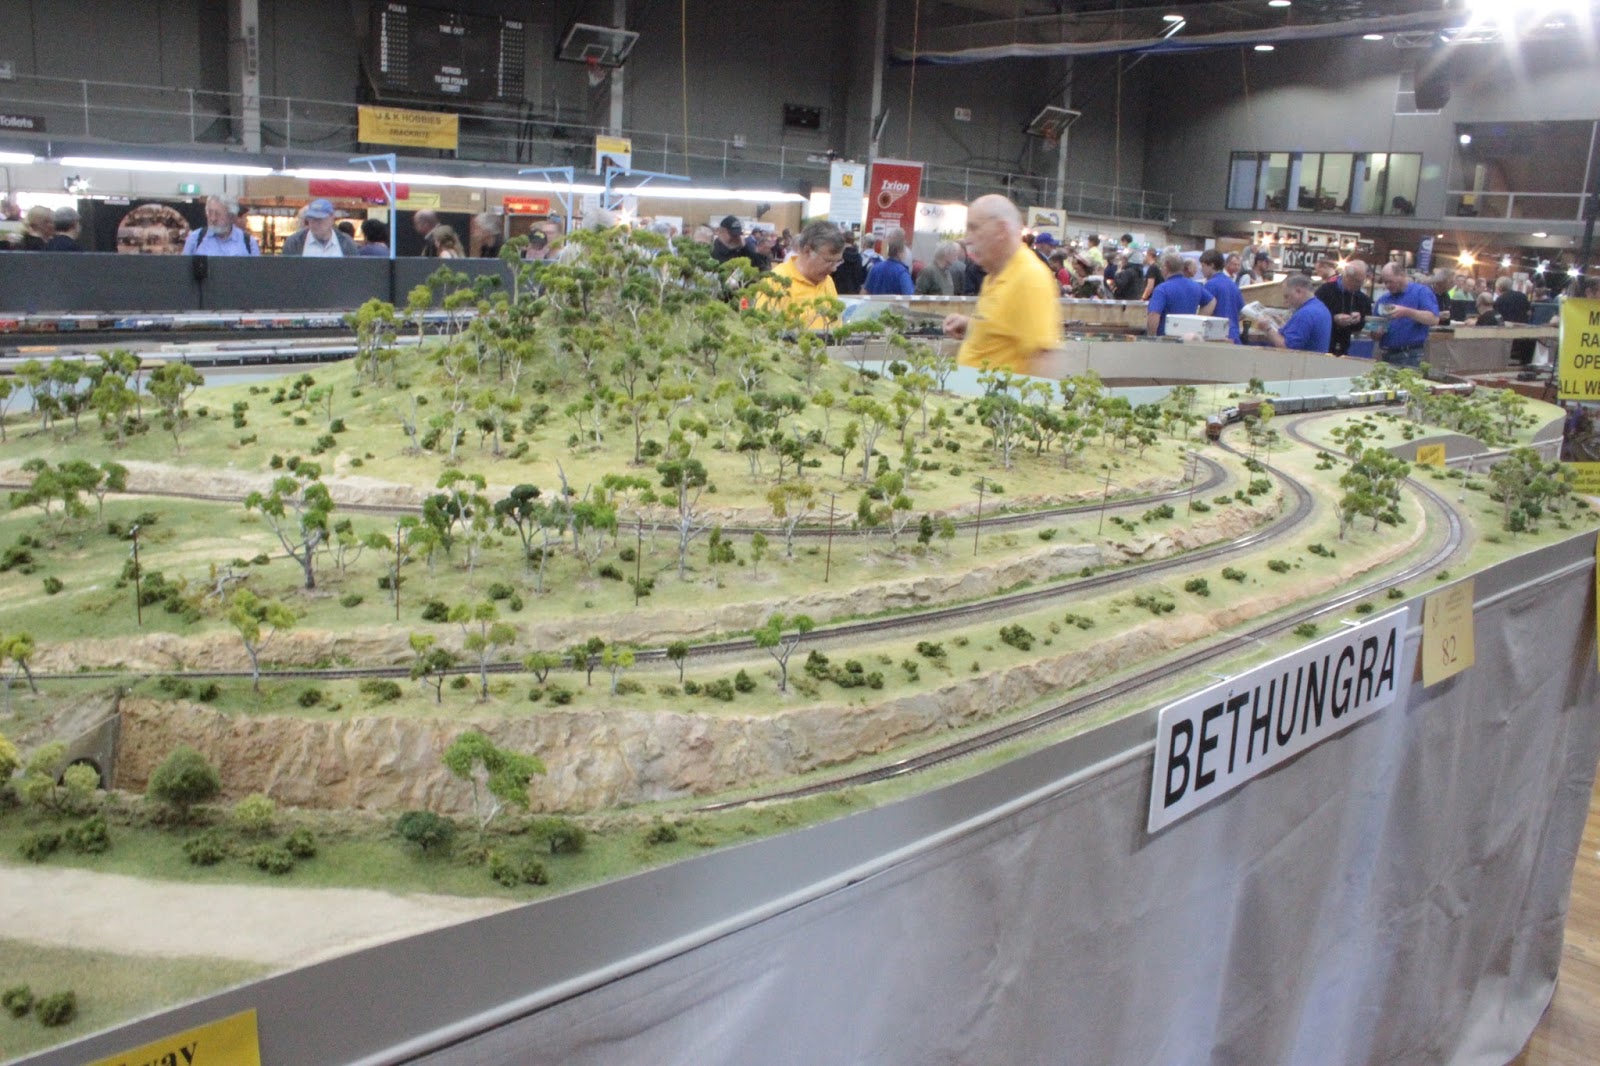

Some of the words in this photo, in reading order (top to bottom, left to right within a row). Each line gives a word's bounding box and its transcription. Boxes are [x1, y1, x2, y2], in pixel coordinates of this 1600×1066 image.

[0, 115, 34, 129] Toilets
[402, 114, 442, 125] HOBBIES
[881, 179, 911, 193] Ixion
[1442, 634, 1457, 667] 82
[1164, 627, 1397, 809] BETHUNGRA
